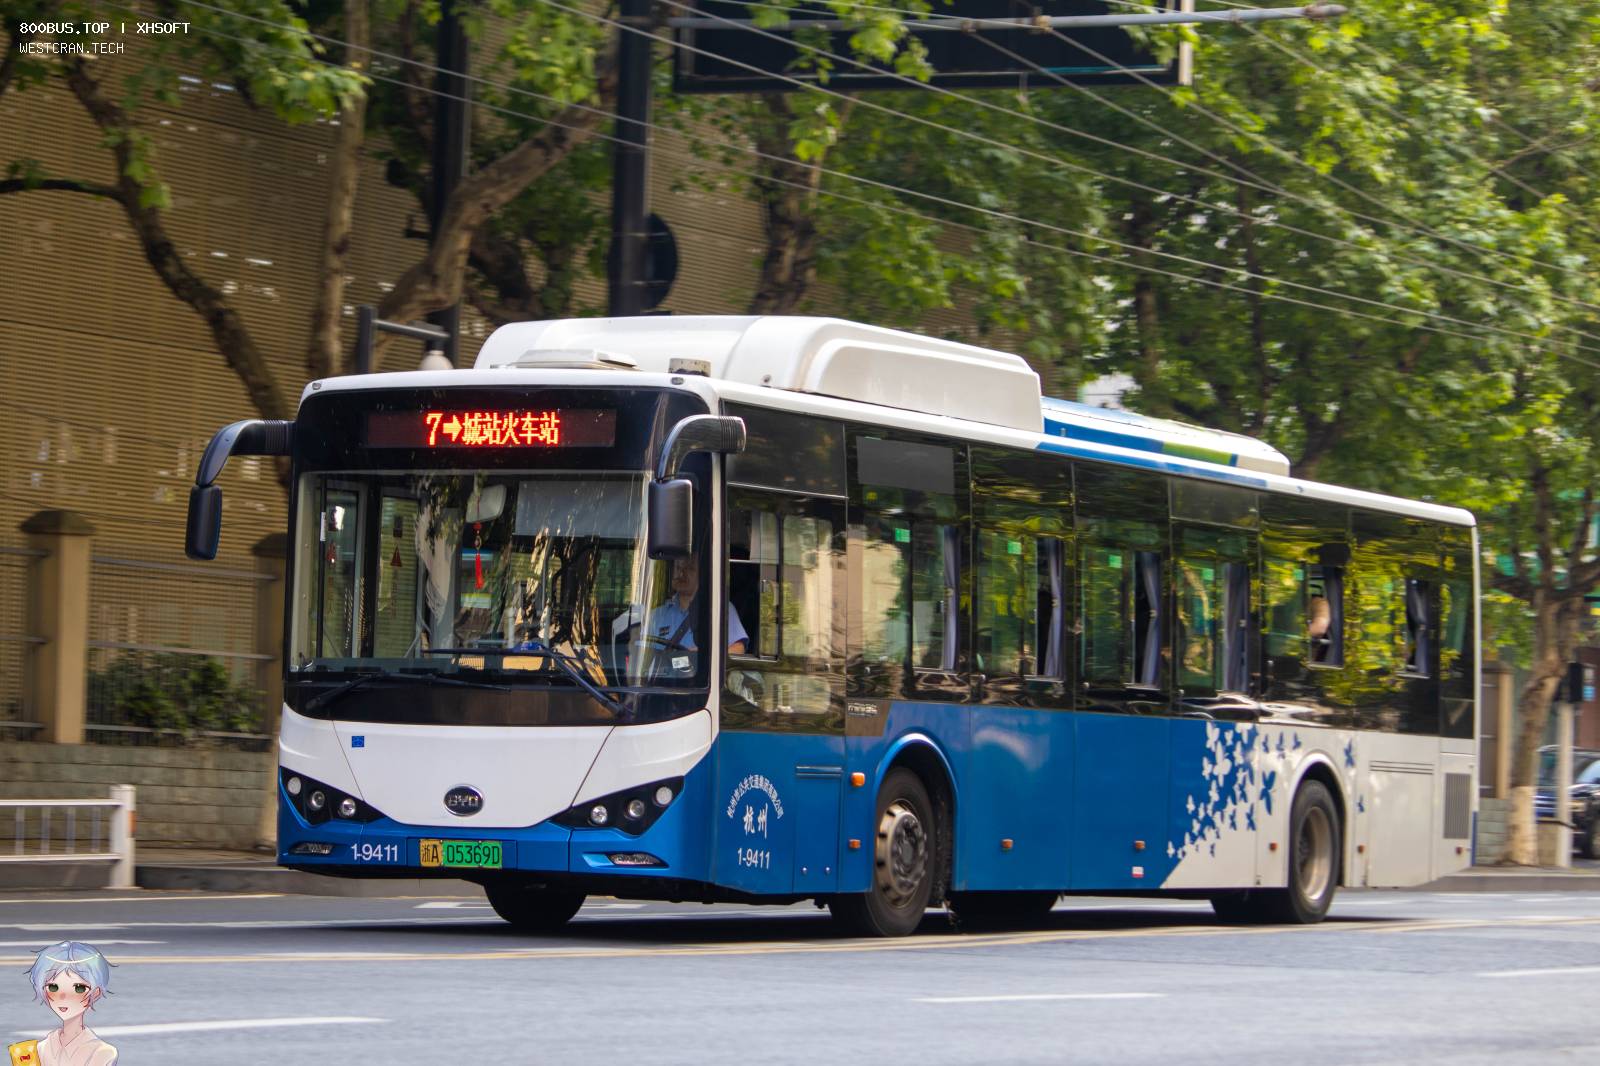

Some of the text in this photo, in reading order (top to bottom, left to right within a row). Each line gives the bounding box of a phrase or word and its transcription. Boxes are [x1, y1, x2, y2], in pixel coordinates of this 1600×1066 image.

[426, 412, 560, 445] 7 城站火车站
[351, 843, 398, 862] 1-9411
[737, 847, 770, 870] 1-9411
